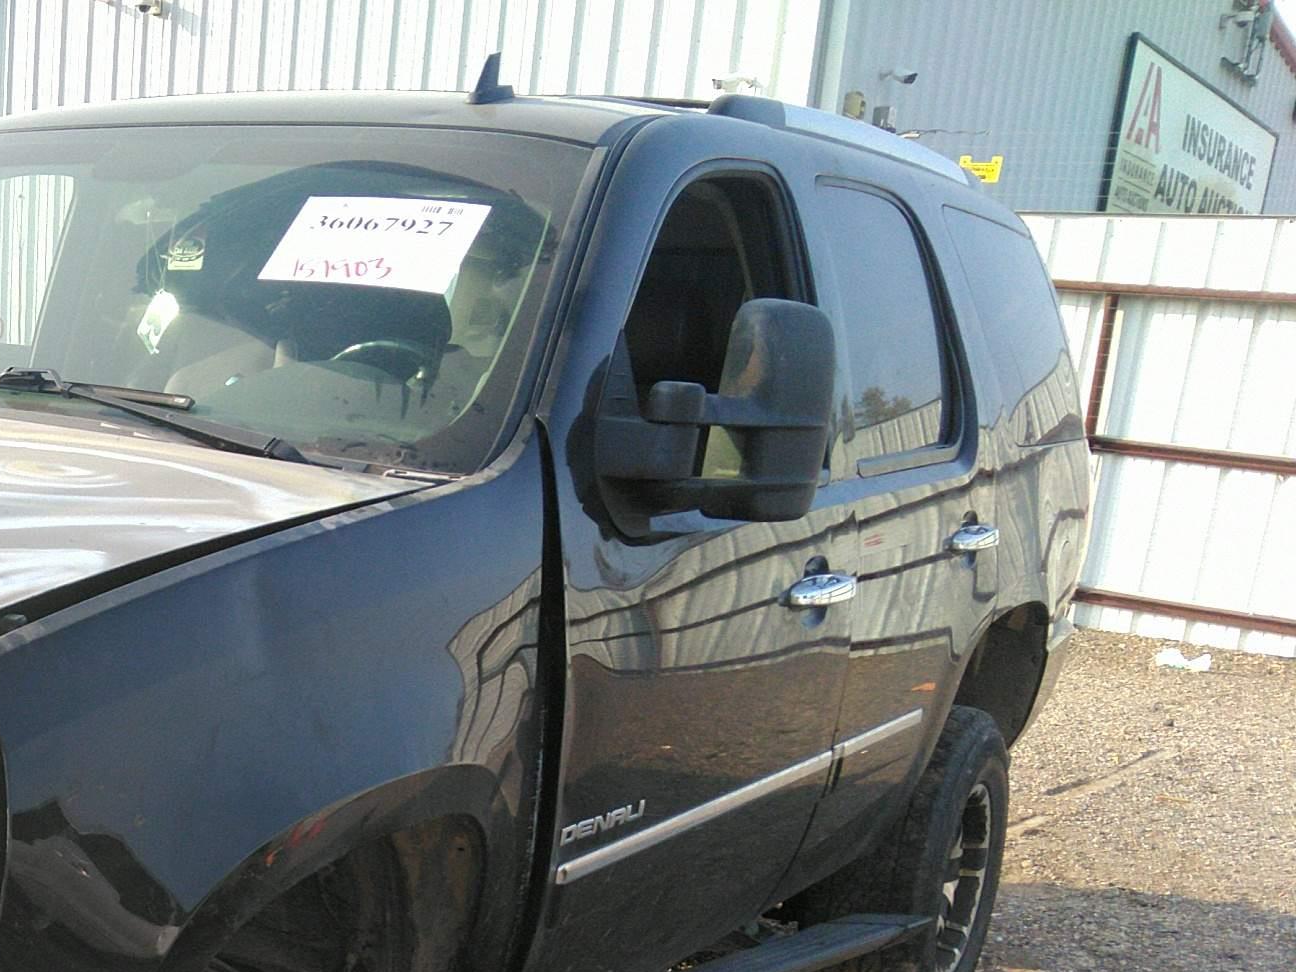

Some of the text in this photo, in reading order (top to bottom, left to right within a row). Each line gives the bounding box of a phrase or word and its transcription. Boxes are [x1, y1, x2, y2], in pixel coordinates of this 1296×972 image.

[1182, 114, 1257, 190] INSURANCE
[1154, 164, 1197, 213] AUTO
[319, 215, 453, 236] 36067927
[559, 799, 646, 847] DENALI
